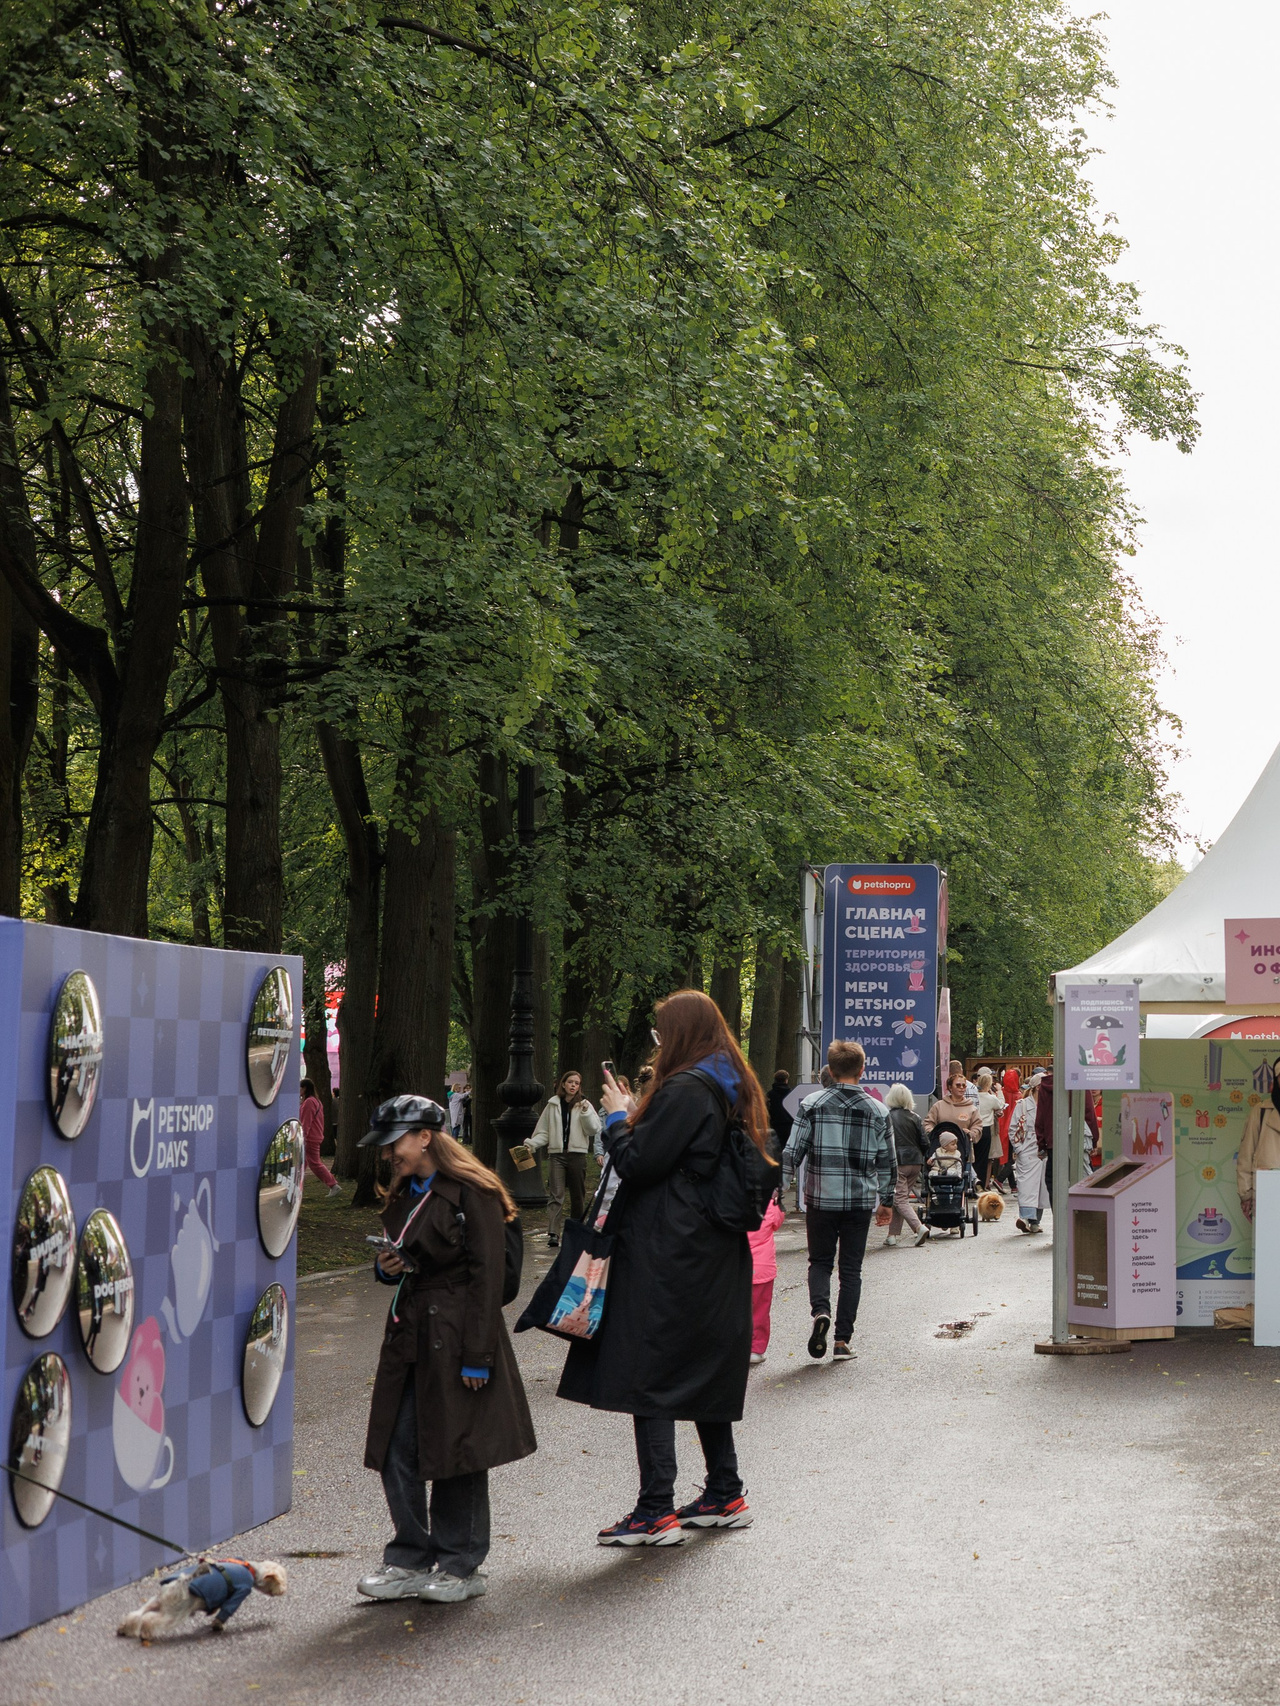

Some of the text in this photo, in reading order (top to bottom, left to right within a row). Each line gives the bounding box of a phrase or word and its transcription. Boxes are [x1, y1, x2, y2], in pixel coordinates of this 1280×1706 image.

[864, 881, 910, 890] petshopru
[846, 908, 926, 920] ГЛАВНАЯ
[844, 926, 905, 940] СЦЕНА
[845, 950, 925, 959] ТЕРРИТОРИЯ
[845, 962, 911, 972] ЗДОРОВЬЯ
[1254, 963, 1266, 974] О
[845, 982, 888, 992] МЕРЧ
[845, 999, 916, 1010] PETSHOP
[844, 1016, 882, 1026] DAYS
[864, 1057, 879, 1066] НА
[860, 1072, 914, 1080] АНЕНИЯ
[1218, 1106, 1243, 1114] Organix
[158, 1104, 214, 1133] PETSHOP
[157, 1140, 188, 1169] DAYS
[94, 1283, 114, 1298] DOG
